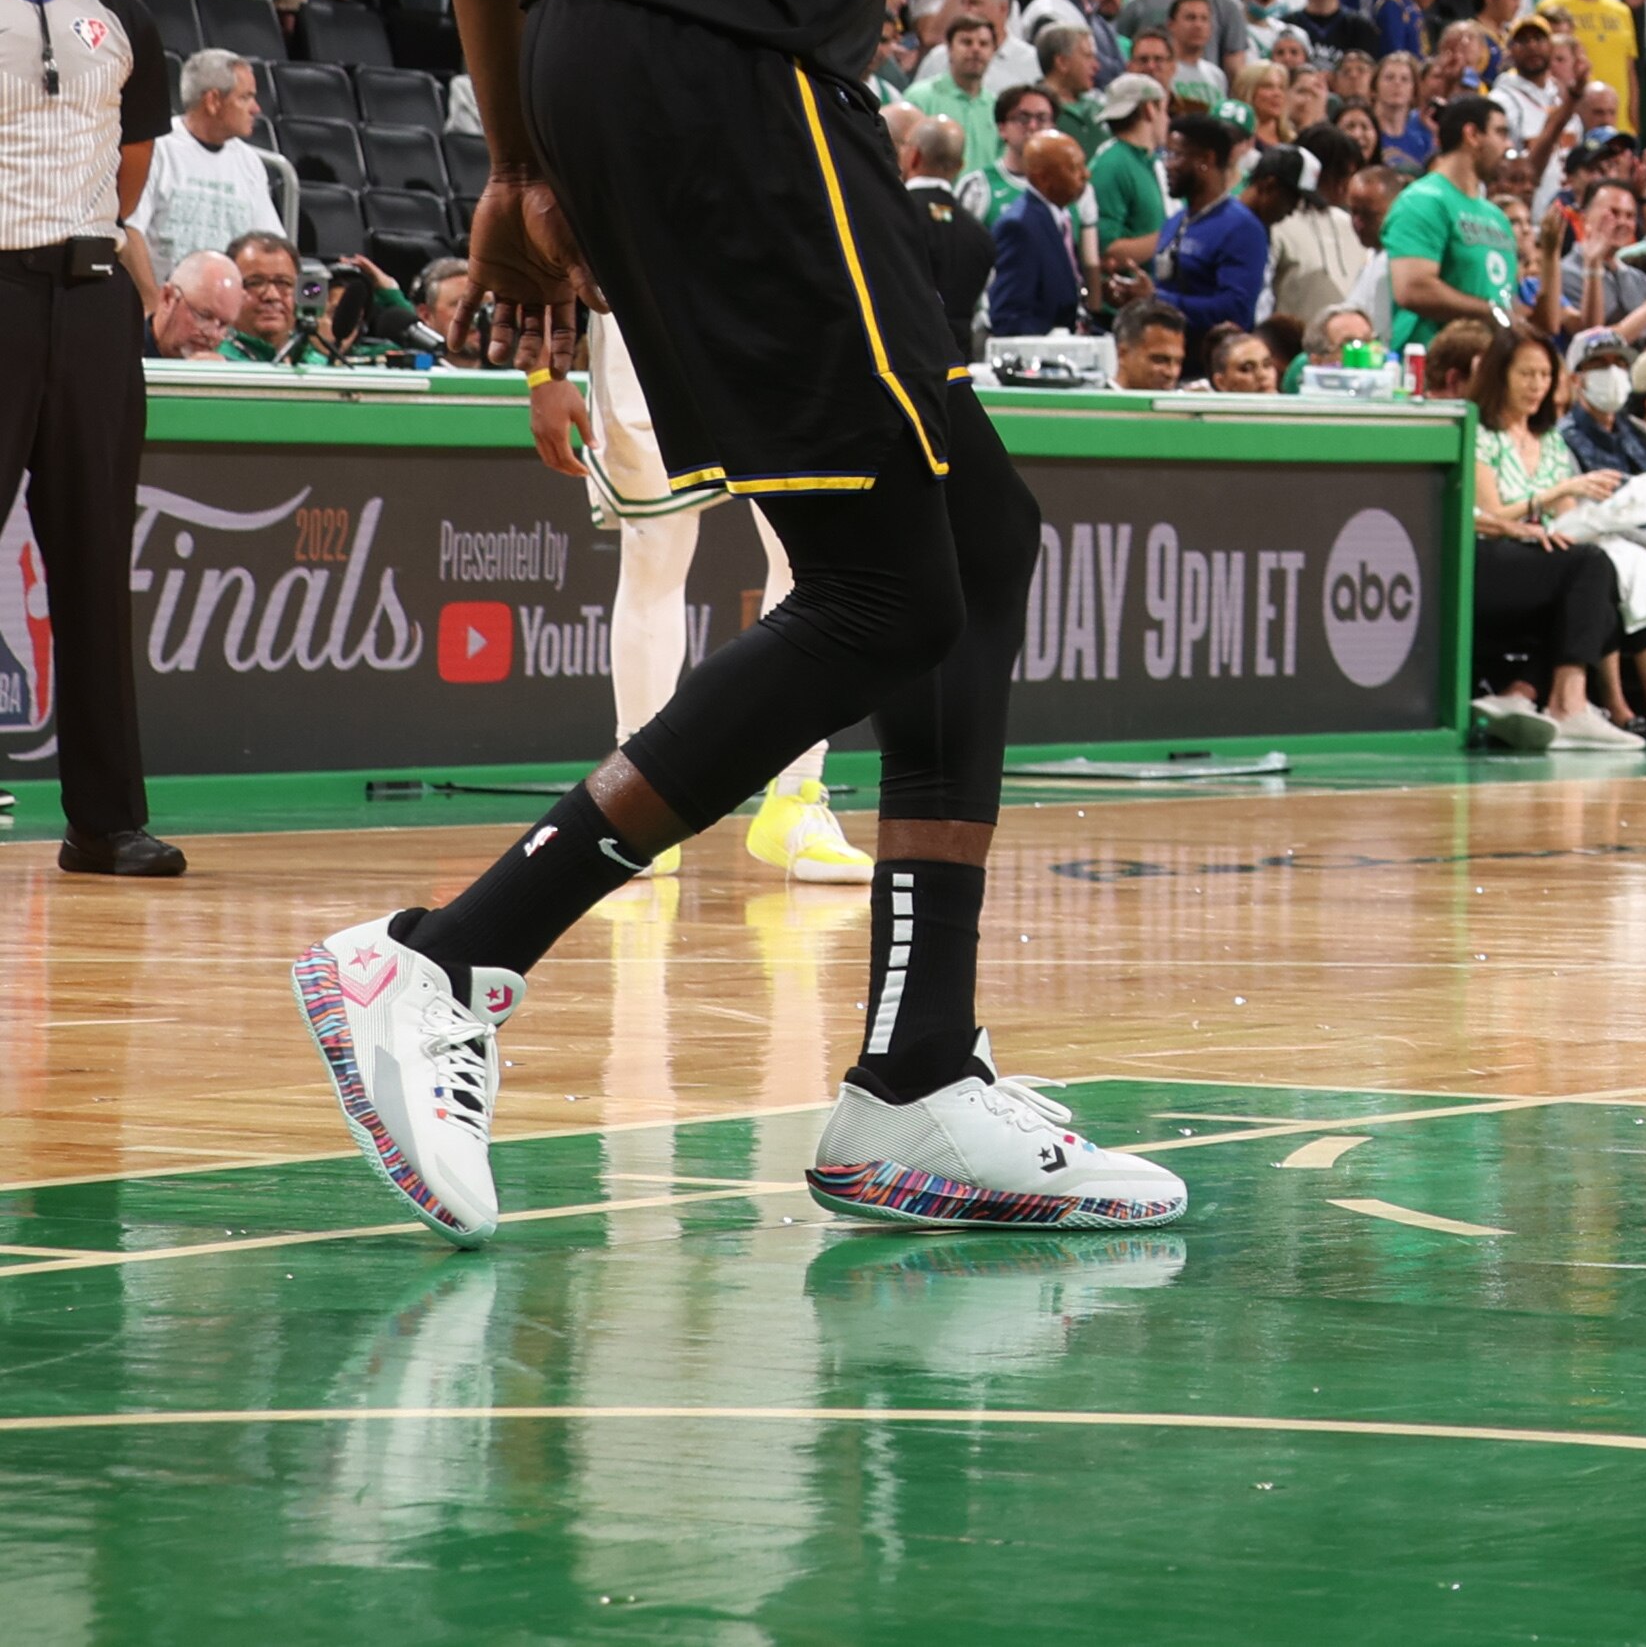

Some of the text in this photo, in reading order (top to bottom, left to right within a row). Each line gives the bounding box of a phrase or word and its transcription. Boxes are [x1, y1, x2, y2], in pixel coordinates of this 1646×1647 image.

[295, 508, 348, 562] 2022
[439, 520, 568, 591] Presented by
[1144, 522, 1244, 680] 9PM
[1254, 550, 1305, 677] ET
[1331, 560, 1414, 623] abc
[520, 605, 612, 677] YouTu
